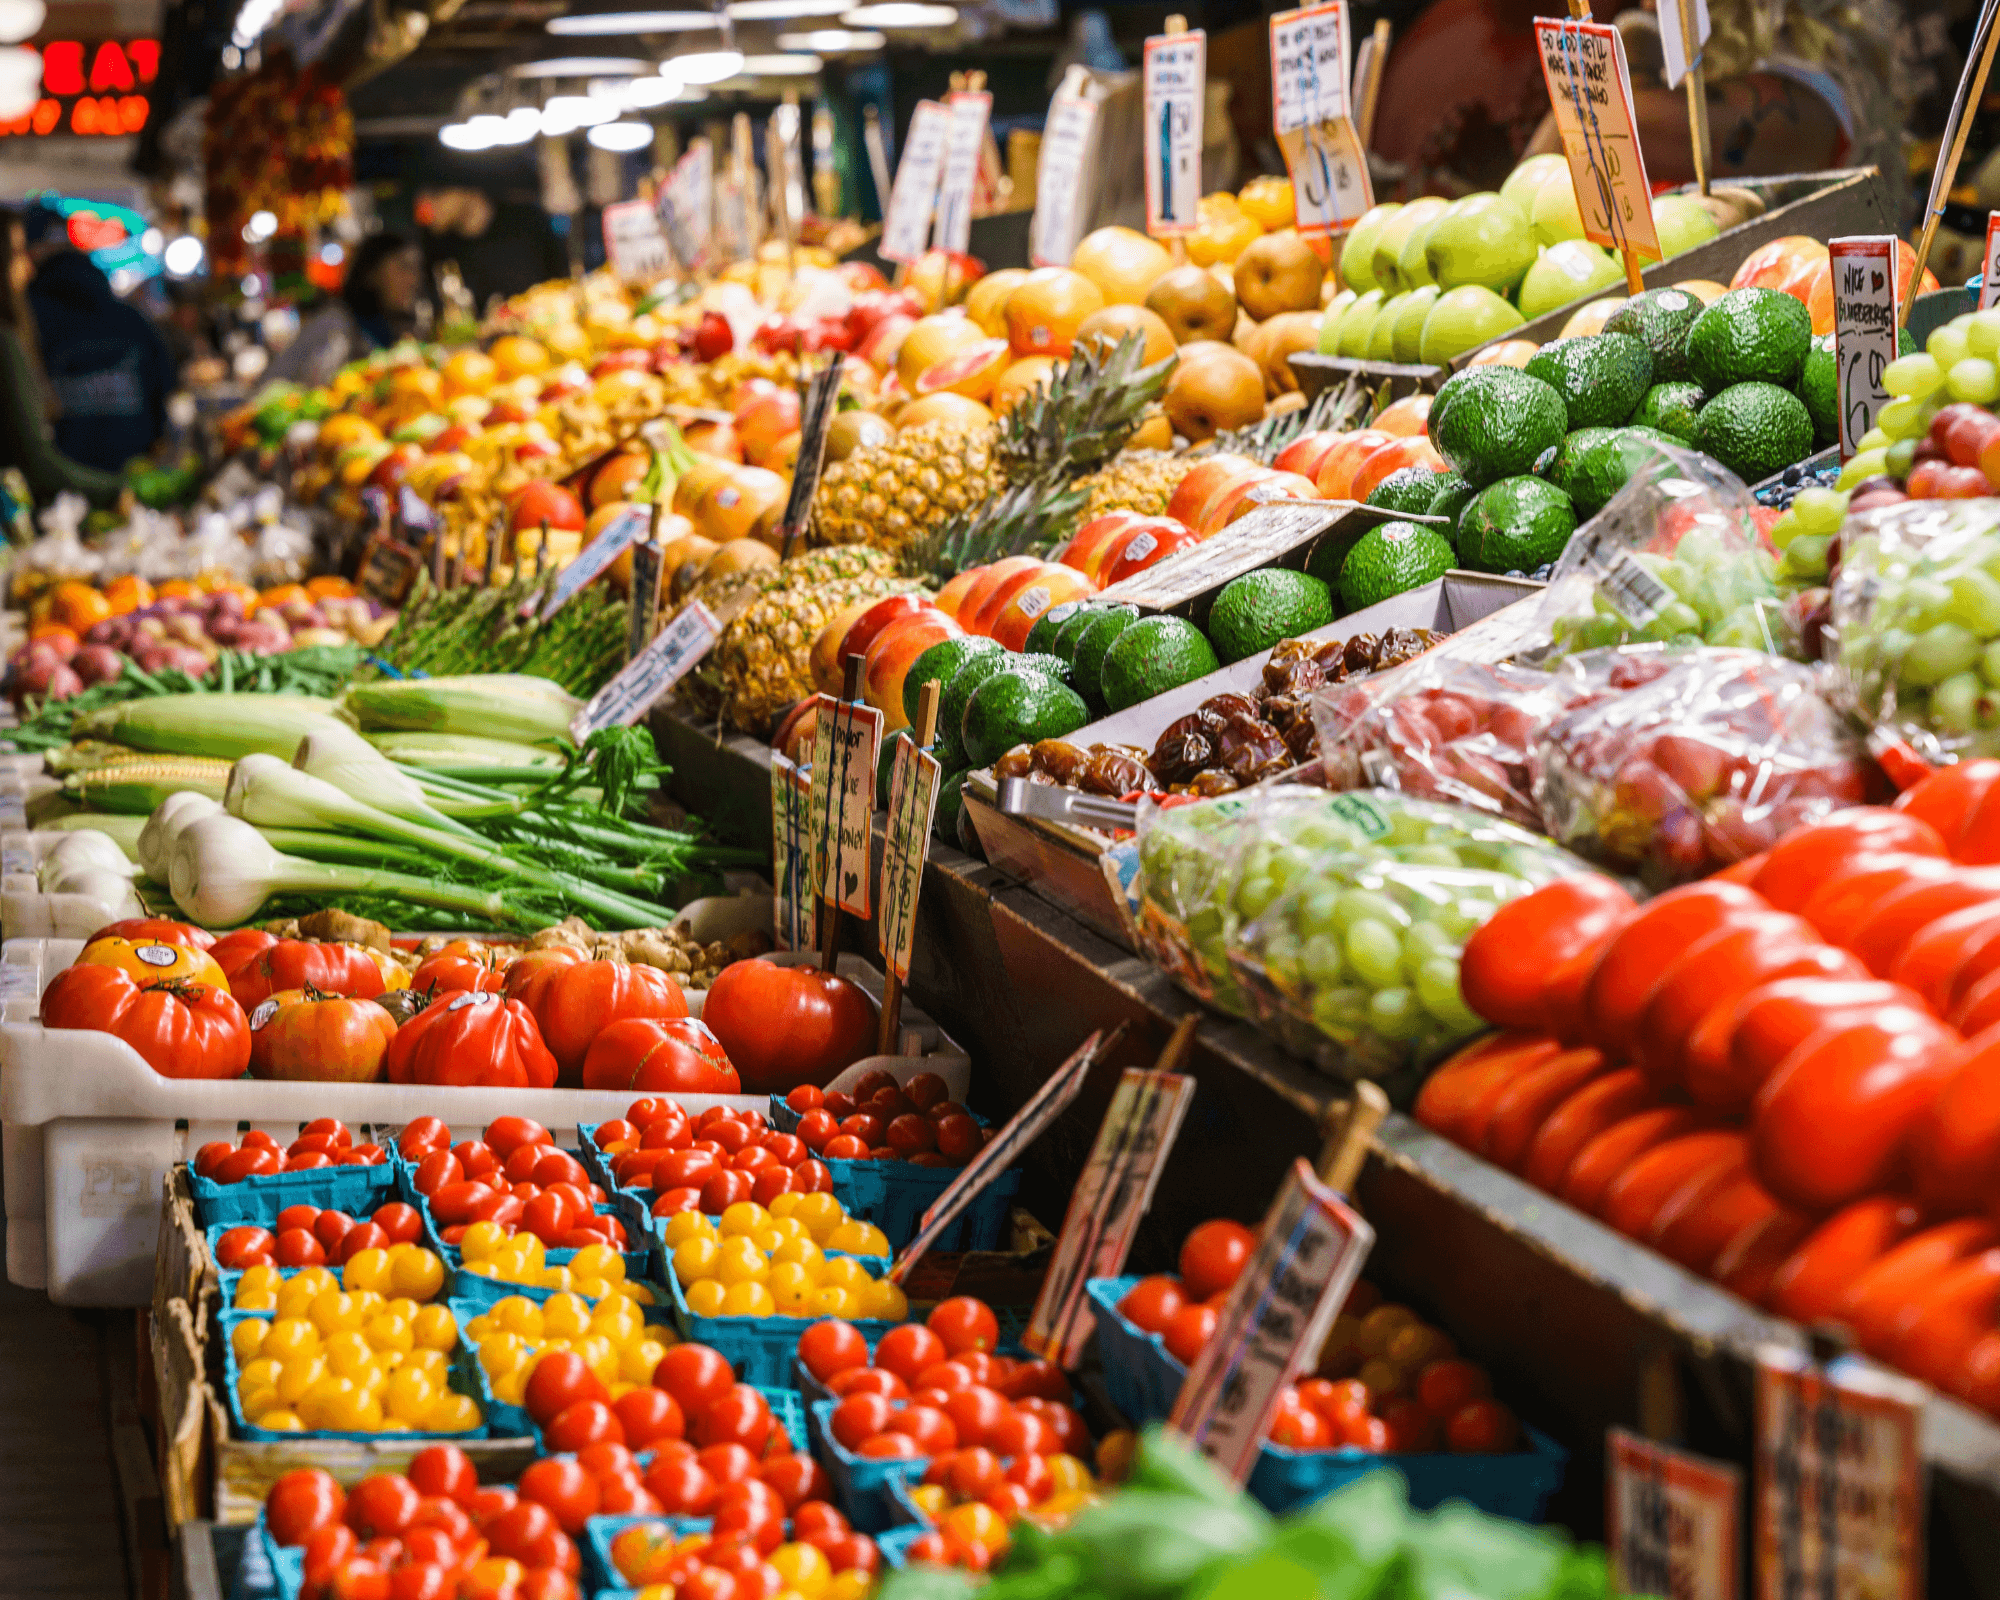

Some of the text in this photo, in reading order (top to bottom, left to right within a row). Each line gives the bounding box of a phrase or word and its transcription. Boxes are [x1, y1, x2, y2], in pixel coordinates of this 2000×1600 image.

[1542, 28, 1553, 50] SO
[24, 39, 163, 95] EAT
[1844, 263, 1865, 296] NICE
